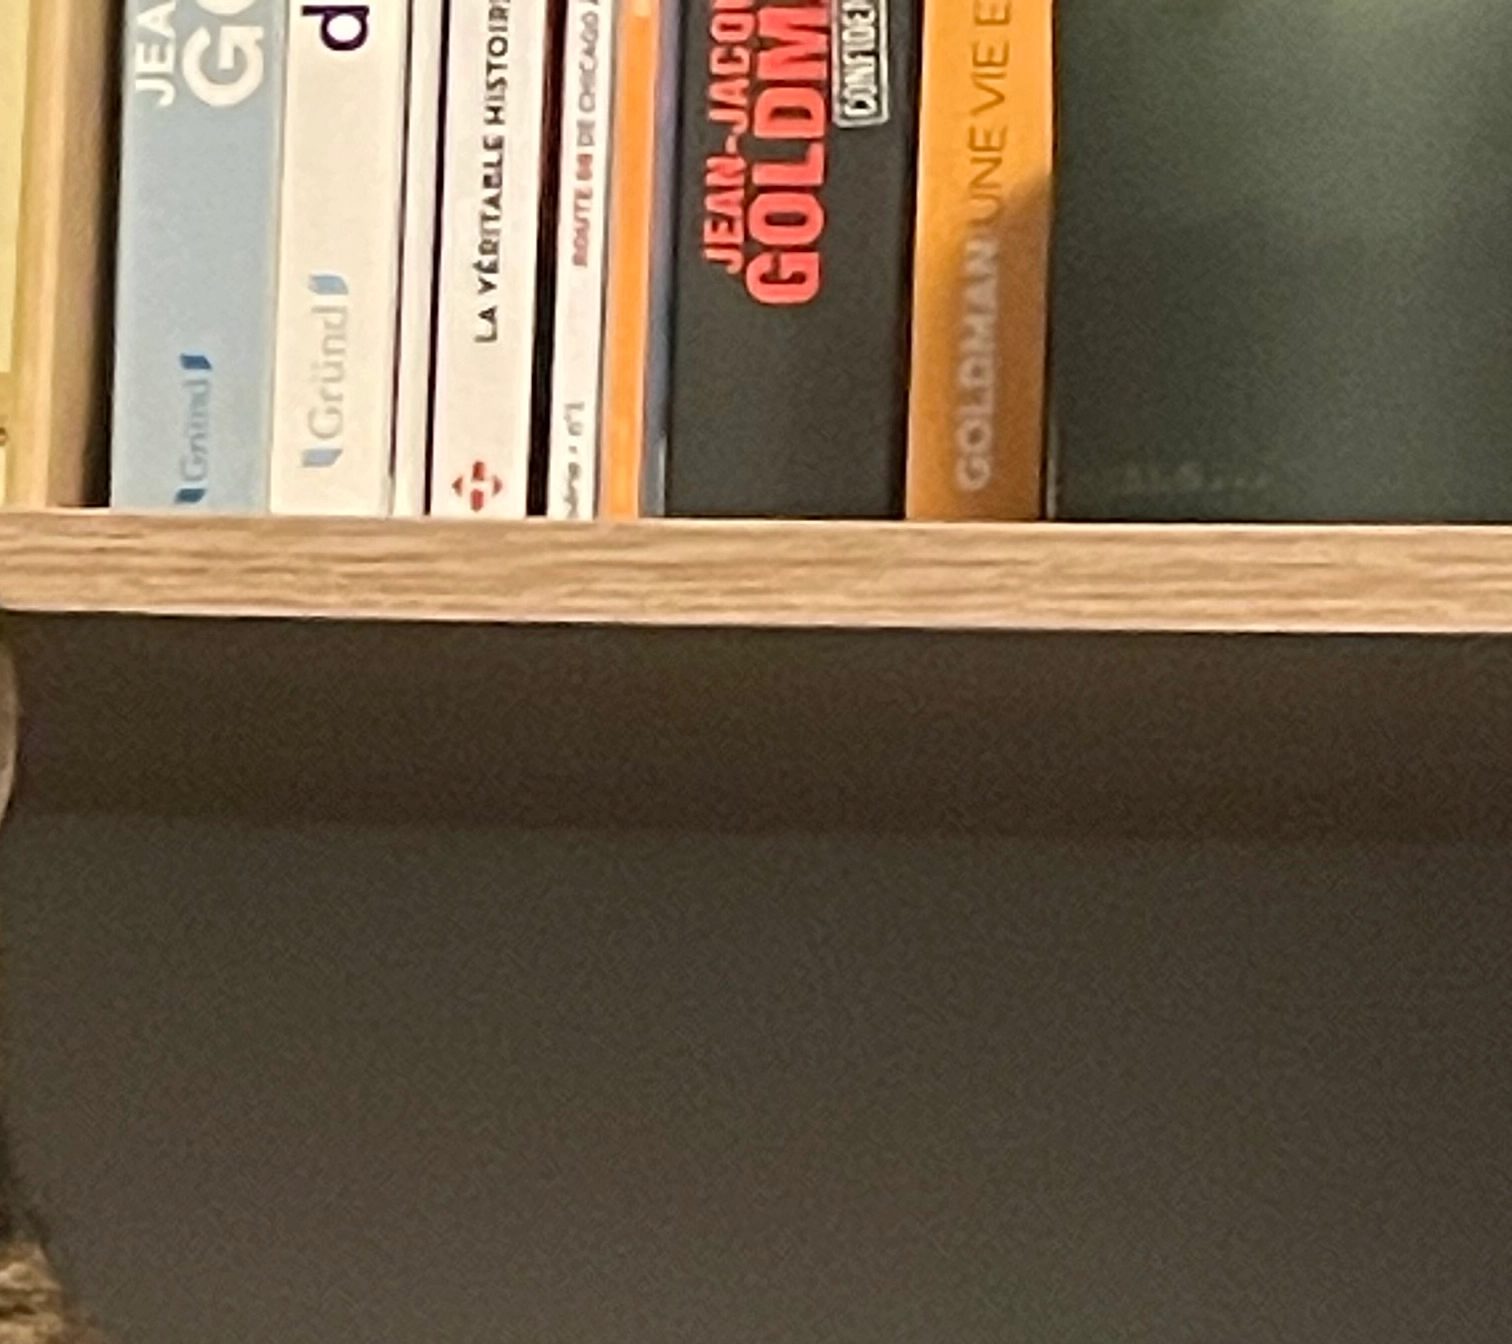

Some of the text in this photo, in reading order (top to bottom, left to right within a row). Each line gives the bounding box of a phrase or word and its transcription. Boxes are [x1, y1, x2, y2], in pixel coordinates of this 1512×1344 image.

[181, 0, 265, 108] G
[301, 4, 370, 51] d
[969, 41, 1009, 117] VIE
[472, 0, 510, 343] LA VÉRITABLE HISTOIR
[745, 0, 829, 305] GOLDM
[968, 125, 1007, 228] UNE
[307, 305, 348, 440] Gründ
[954, 238, 999, 492] GOLDMAN
